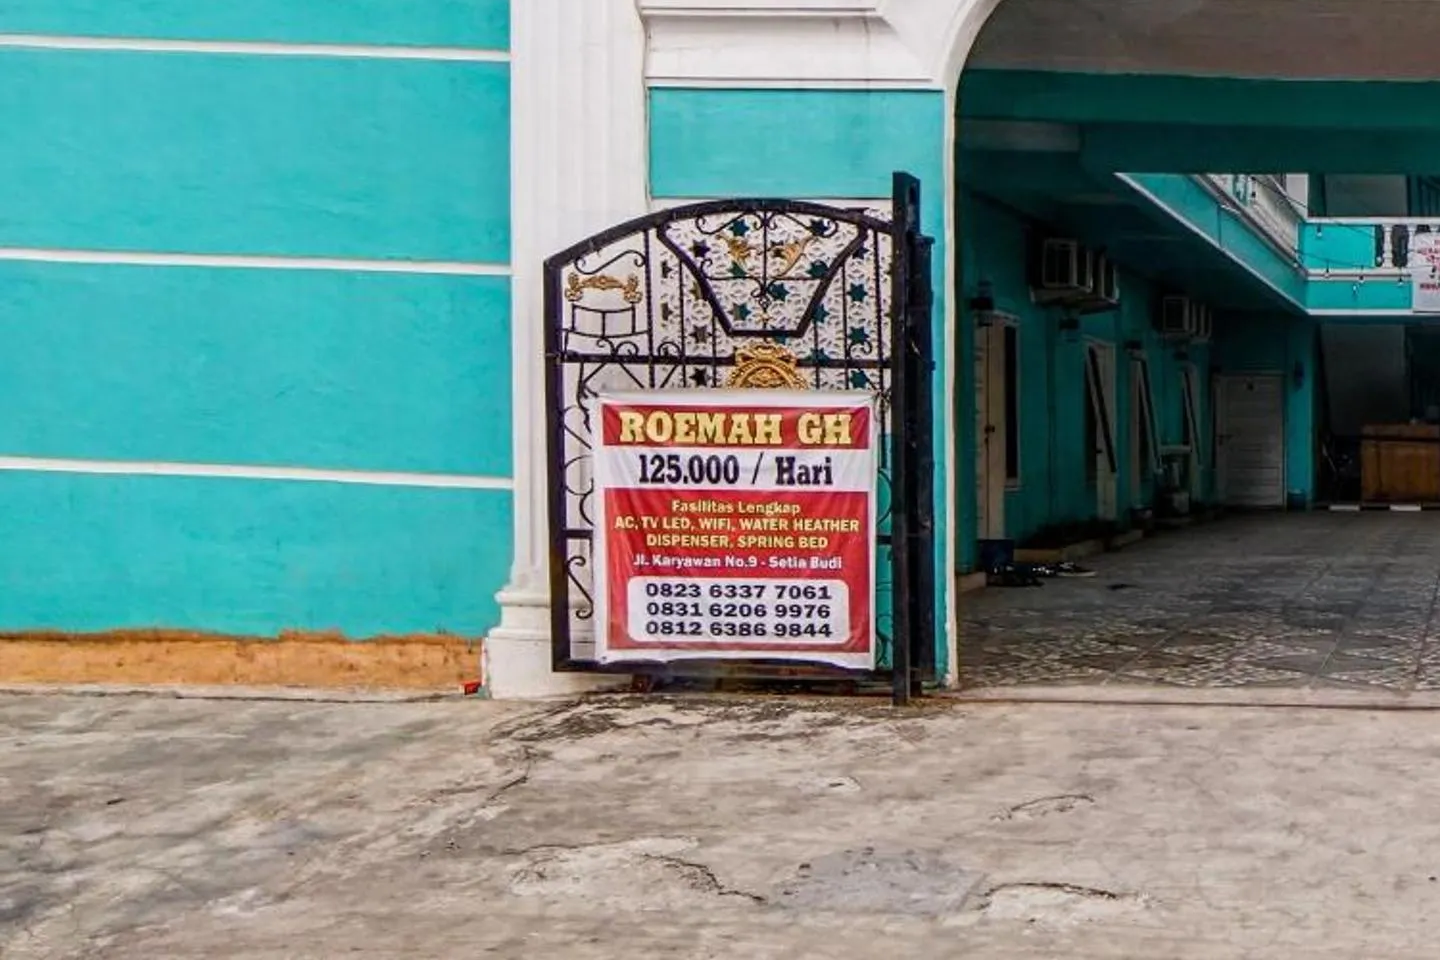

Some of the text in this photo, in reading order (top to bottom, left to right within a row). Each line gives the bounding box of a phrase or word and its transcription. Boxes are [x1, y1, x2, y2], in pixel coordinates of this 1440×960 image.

[618, 411, 852, 445] ROEMAH GH
[638, 451, 833, 485] 125.000 / Hari
[672, 500, 800, 516] Fasilitas Lengkap
[615, 516, 639, 530] AC,
[640, 516, 659, 529] TV
[663, 517, 695, 531] LED,
[738, 518, 788, 531] WATER
[793, 519, 859, 532] HEATHER
[646, 534, 828, 548] DISPENSER, SPRING BED
[652, 554, 721, 569] Karyawan
[725, 555, 757, 568] No.9
[768, 556, 807, 569] Setia
[810, 556, 842, 569] Budi
[645, 582, 832, 600] 0823 6337 7061
[646, 602, 831, 619] 0831 6206 9976
[646, 620, 832, 638] 0812 6386 9844
